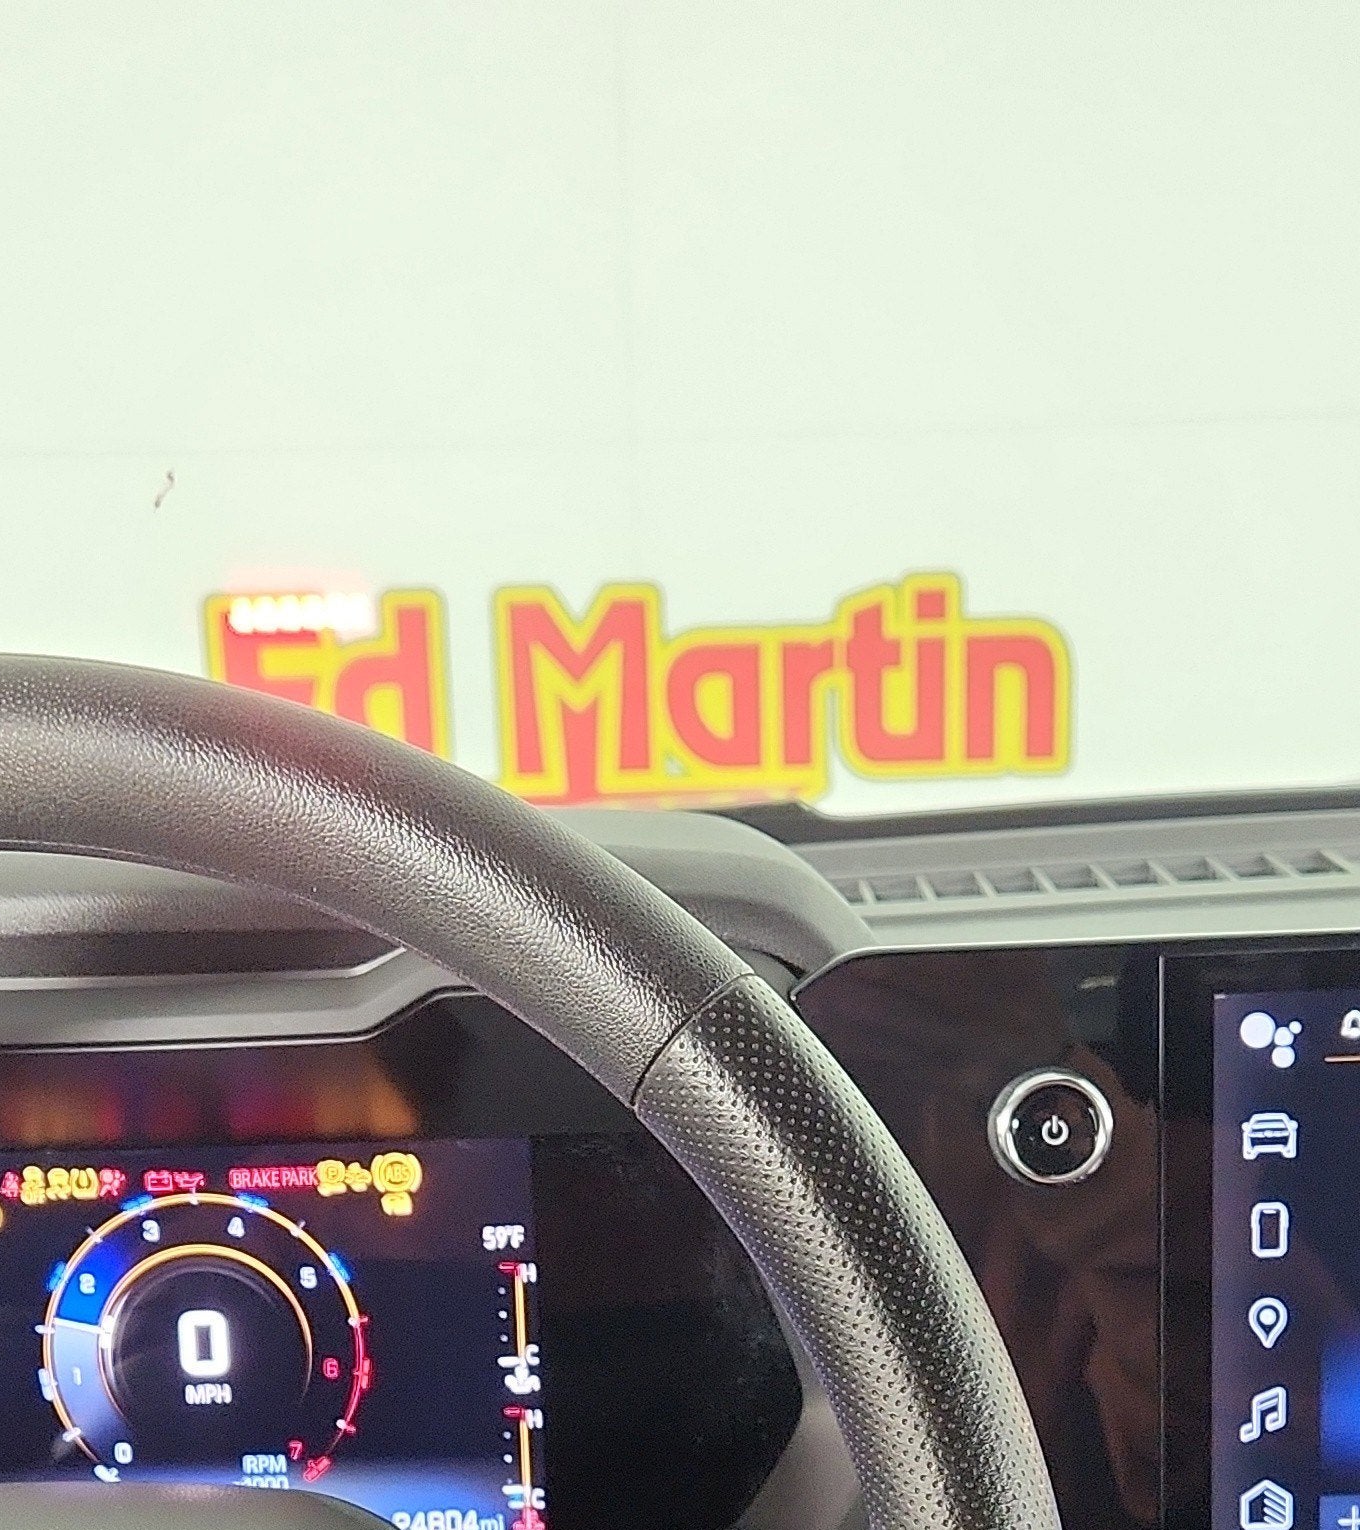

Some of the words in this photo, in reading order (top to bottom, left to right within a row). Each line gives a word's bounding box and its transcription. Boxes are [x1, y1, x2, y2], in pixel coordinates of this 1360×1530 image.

[502, 583, 1062, 775] Martin
[232, 1169, 280, 1188] BRAKE
[281, 1167, 319, 1187] PARK
[142, 1219, 160, 1242] 3
[227, 1216, 245, 1238] 4
[79, 1272, 96, 1294] 2
[299, 1266, 318, 1289] 5
[177, 1309, 231, 1377] 0
[72, 1366, 82, 1386] 1
[323, 1356, 340, 1380] 6
[184, 1383, 233, 1404] MPH
[114, 1442, 133, 1465] 0
[289, 1440, 303, 1461] 7
[242, 1454, 288, 1475] RPM
